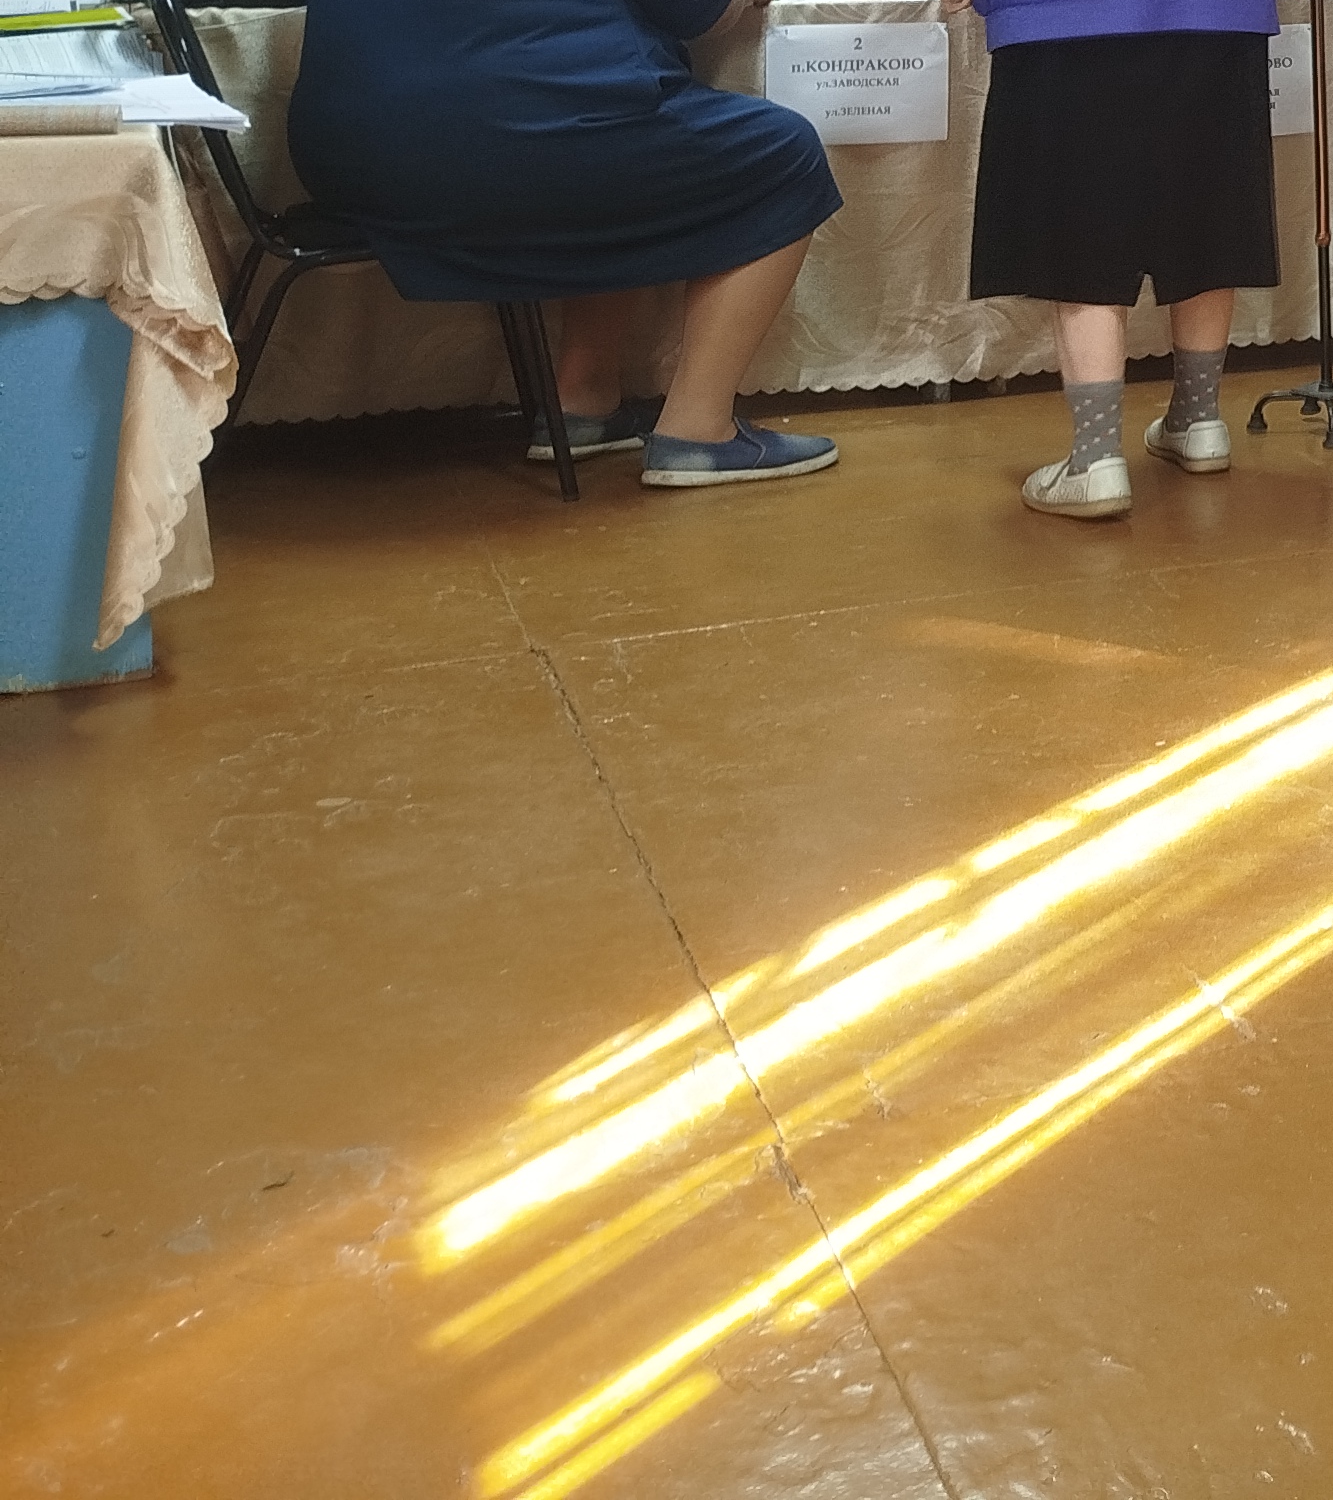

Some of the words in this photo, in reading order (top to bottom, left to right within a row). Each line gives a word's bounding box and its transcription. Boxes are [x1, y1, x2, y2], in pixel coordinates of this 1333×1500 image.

[853, 37, 863, 50] 2
[791, 58, 924, 74] п.КОНДРАКОВО
[816, 77, 900, 90] ул.ЗАВОДСКАЯ
[825, 106, 891, 118] ул.ЗЕЛЕНАЯ
